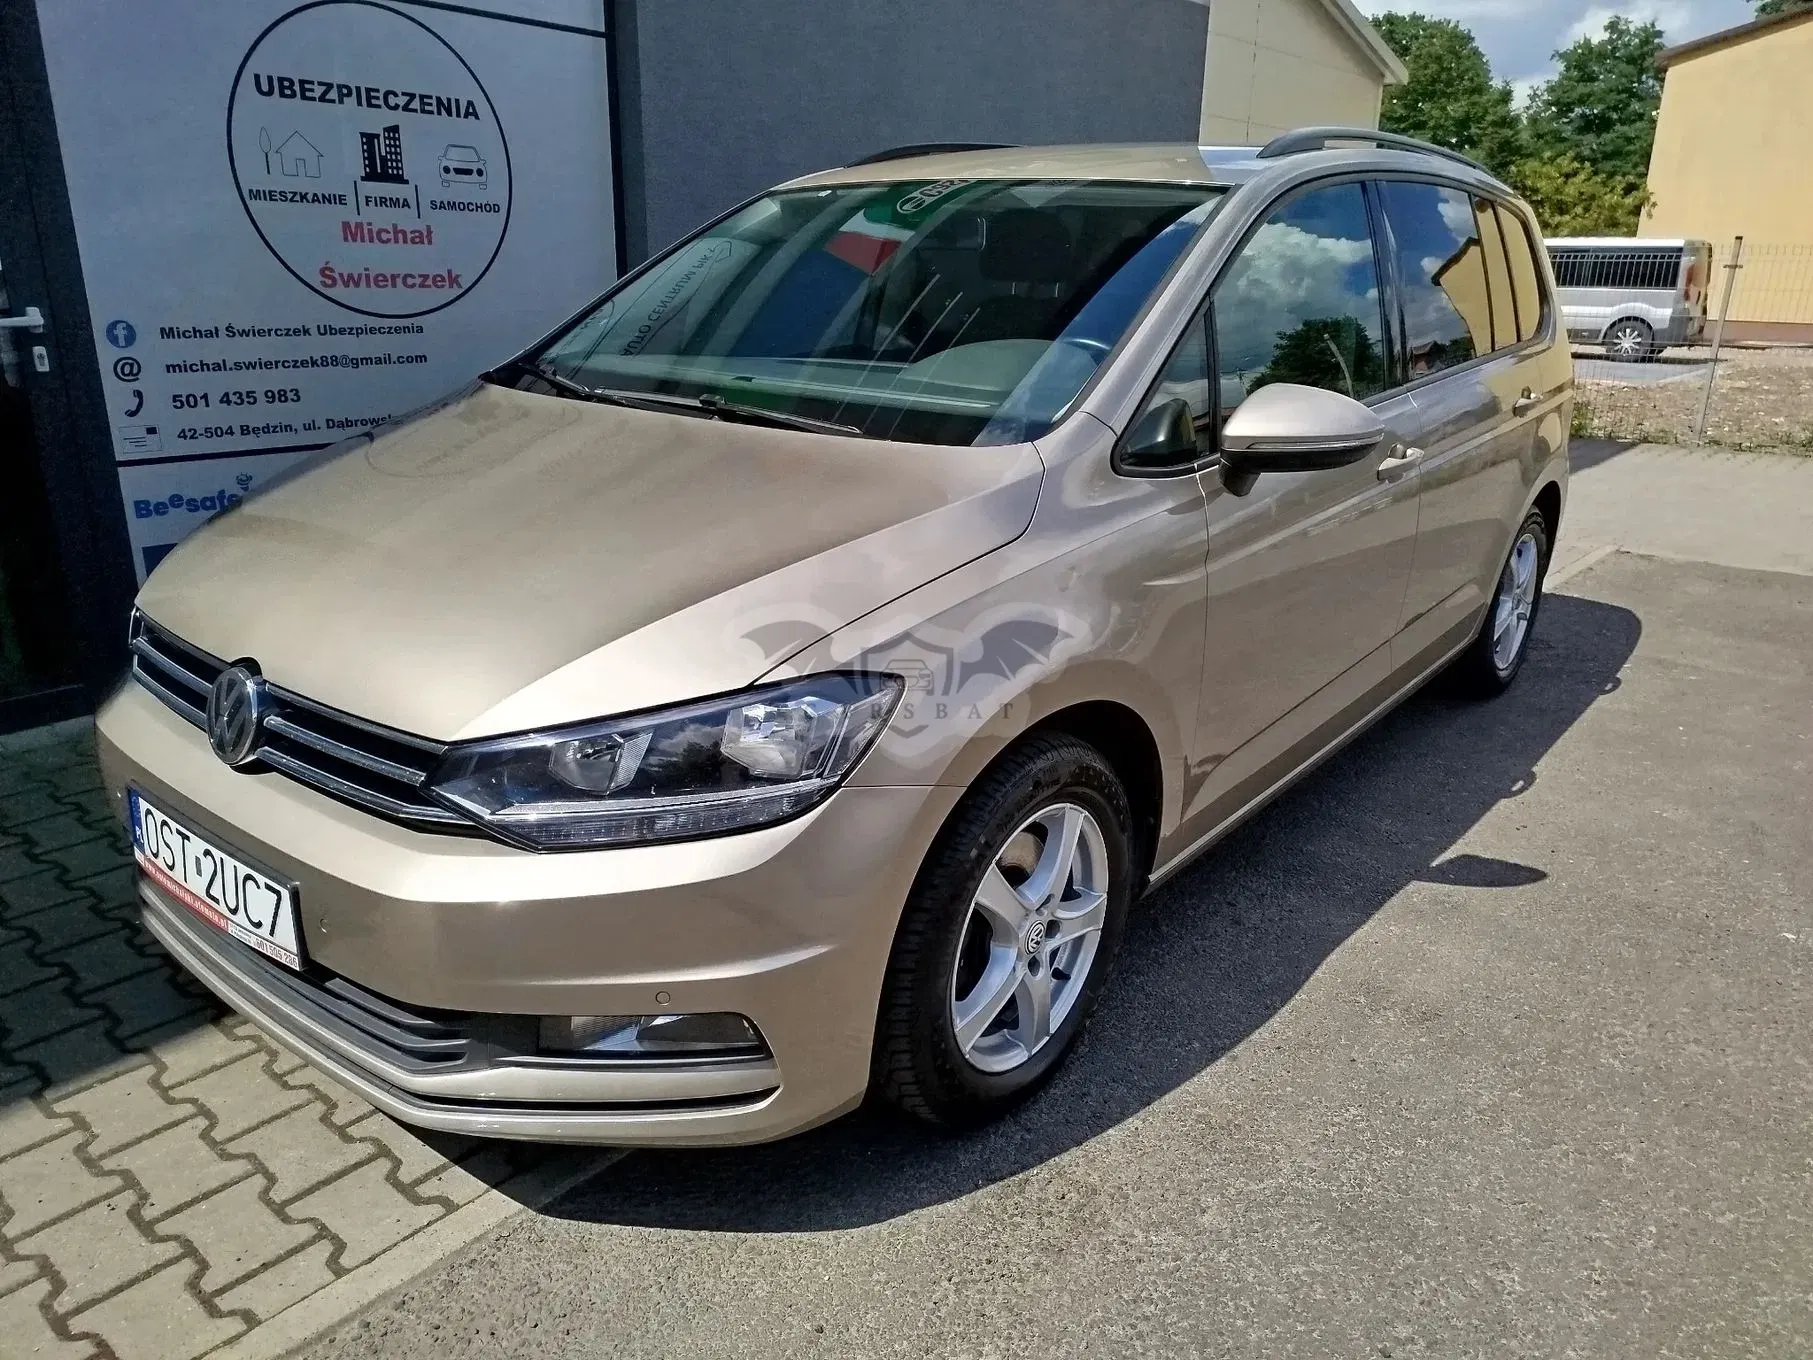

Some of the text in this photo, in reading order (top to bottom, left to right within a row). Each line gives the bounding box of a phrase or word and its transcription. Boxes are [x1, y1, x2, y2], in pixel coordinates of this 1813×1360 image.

[253, 73, 480, 120] UBEZPIECZENIA
[248, 188, 500, 214] MIESZKANIE FIRMA SAMOCHÓD
[341, 221, 434, 246] Michał
[318, 261, 463, 289] Świerczek
[159, 323, 424, 340] Michał Świerczek Ubezpieczenia
[165, 353, 428, 374] michal.swierczek88@gmail.com
[171, 388, 301, 410] 501 435 983
[177, 414, 391, 441] 42-504 Będzin, ul. Dąbrows
[145, 807, 283, 937] OST 2UC7
